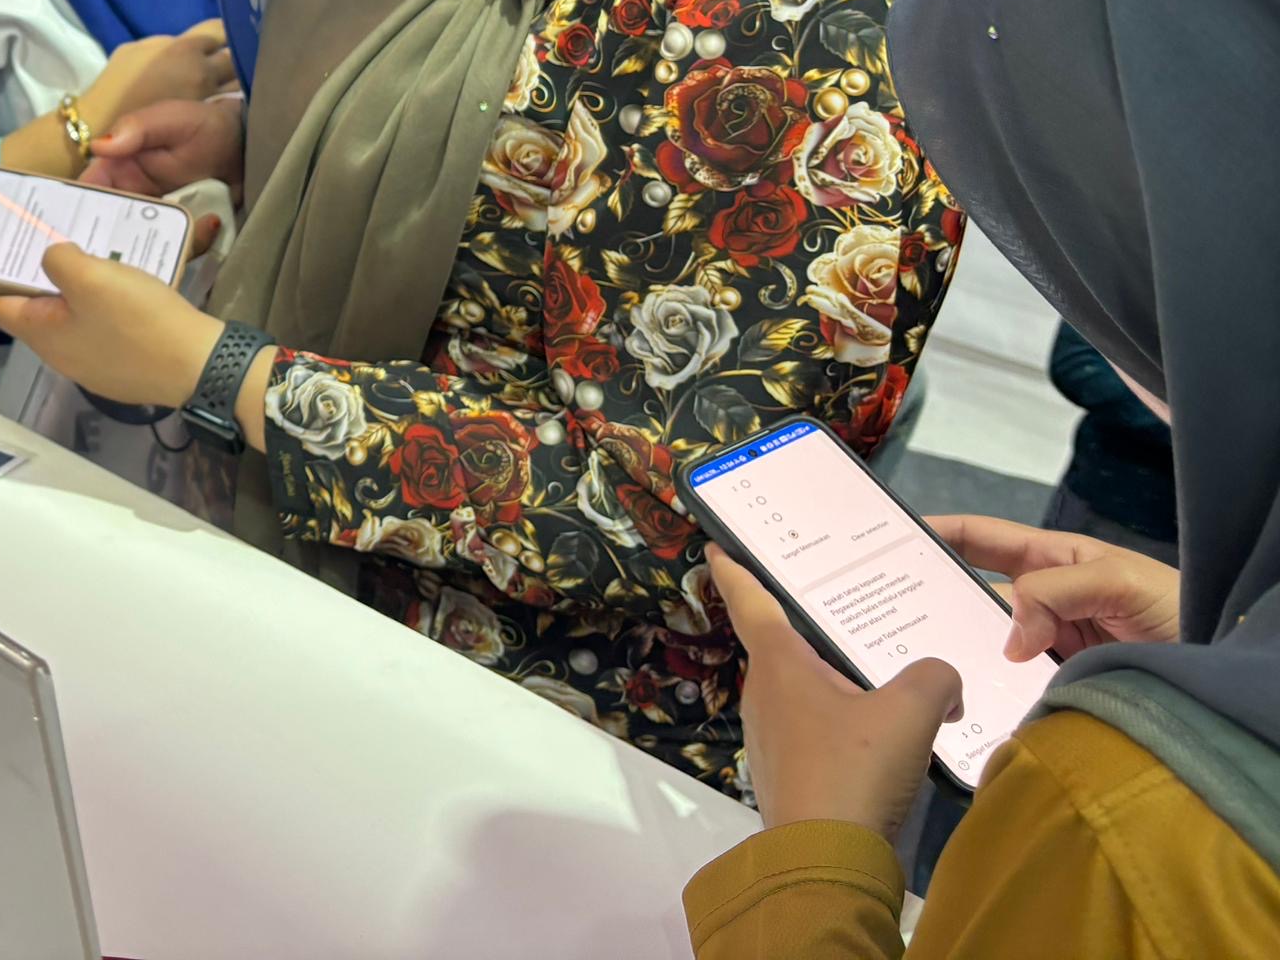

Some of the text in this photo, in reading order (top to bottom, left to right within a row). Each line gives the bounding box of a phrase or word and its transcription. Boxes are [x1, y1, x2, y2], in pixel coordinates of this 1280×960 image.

[860, 571, 887, 591] kepuasan
[839, 611, 863, 626] maklum
[862, 602, 879, 617] balas
[848, 621, 870, 636] telefon
[882, 628, 898, 640] Tidak
[896, 613, 929, 633] Memuaskan
